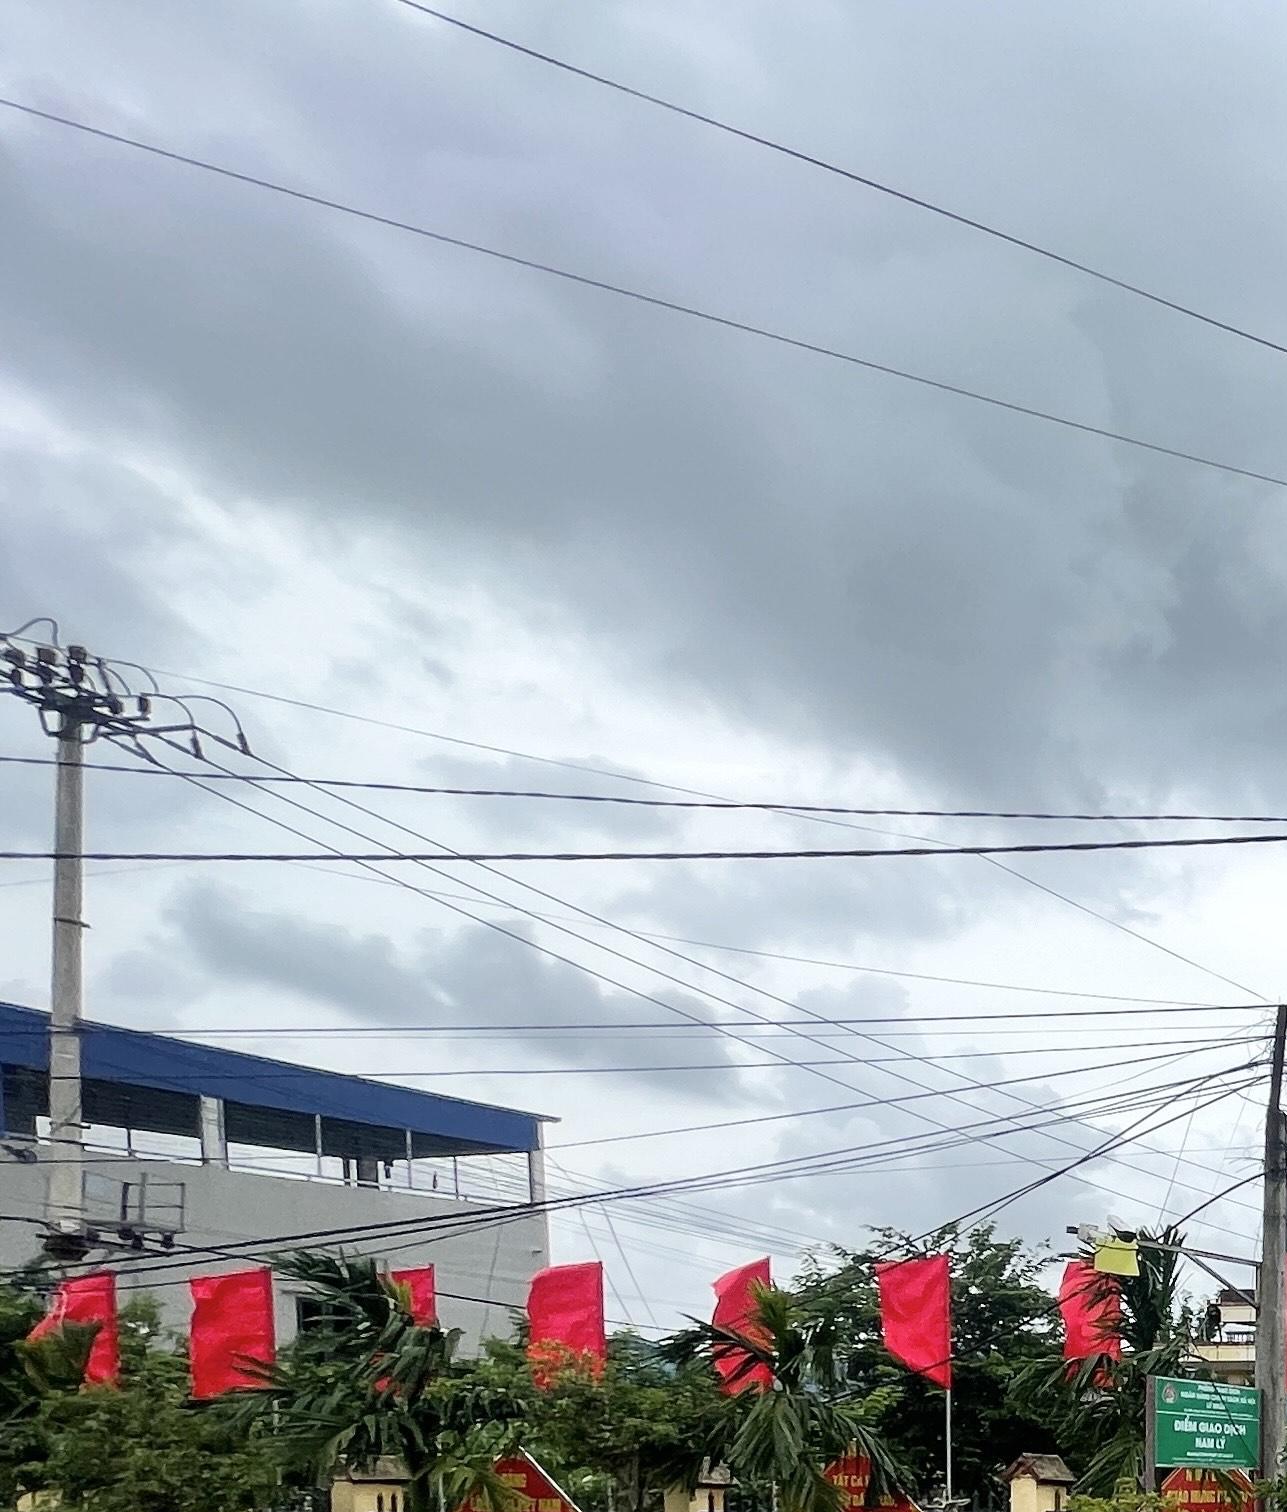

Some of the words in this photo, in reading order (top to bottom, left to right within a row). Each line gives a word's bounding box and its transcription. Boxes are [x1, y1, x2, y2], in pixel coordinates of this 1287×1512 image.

[1174, 1415, 1197, 1432] ĐIỂM
[1198, 1422, 1222, 1434] GIAO
[1223, 1423, 1246, 1437] DỊCH
[1195, 1437, 1215, 1449] NAM
[1216, 1435, 1226, 1449] LÝ
